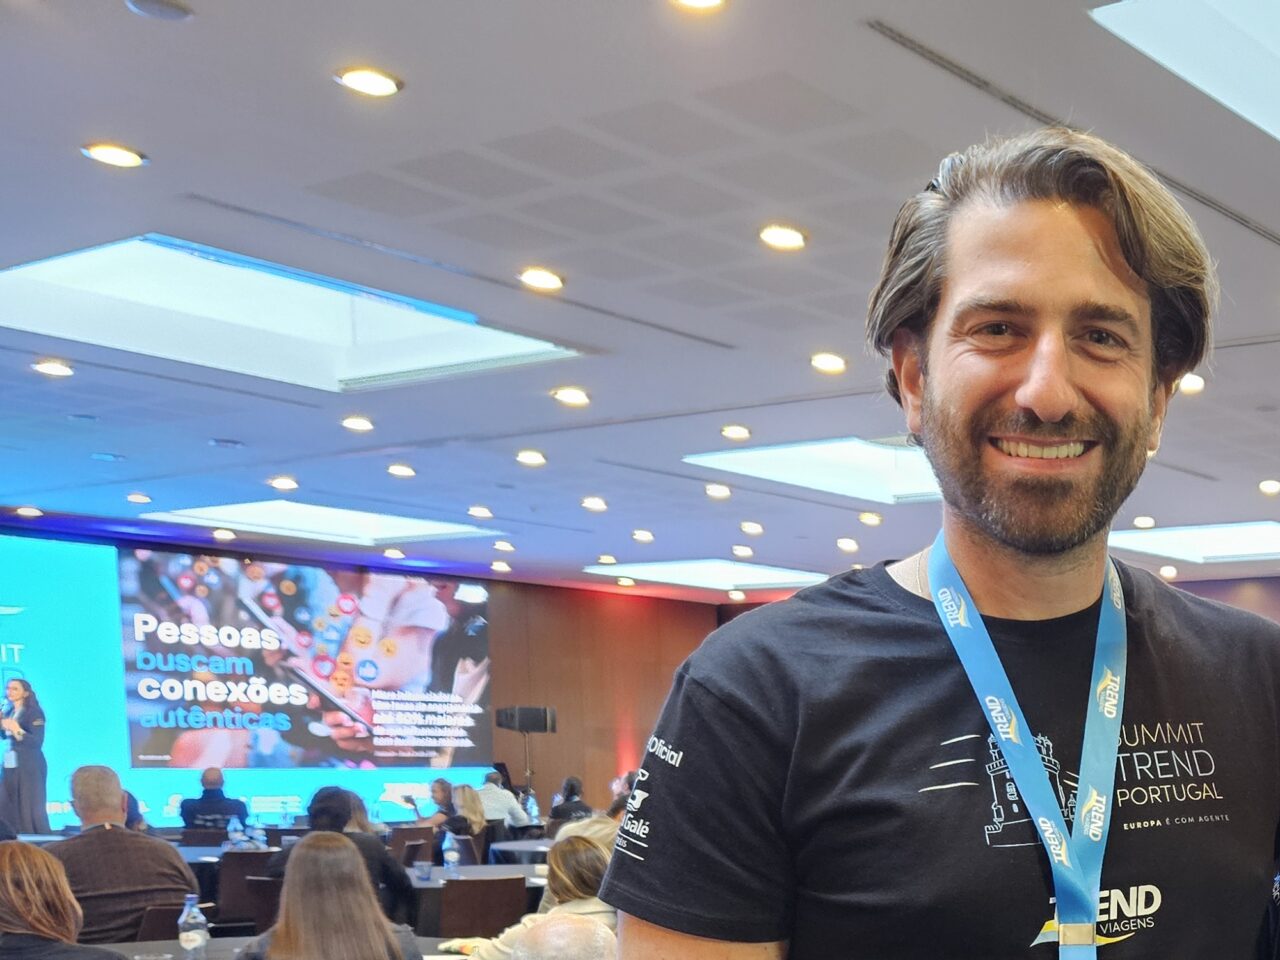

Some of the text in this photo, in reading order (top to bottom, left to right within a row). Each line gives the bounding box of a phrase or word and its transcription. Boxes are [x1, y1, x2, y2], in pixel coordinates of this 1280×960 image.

[938, 588, 960, 628] TREND
[133, 613, 281, 650] Pessoas
[136, 651, 254, 675] buscam
[137, 677, 308, 705] conexões
[1104, 675, 1121, 718] TREND
[140, 705, 292, 731] autênticas
[985, 696, 1011, 742] TREND
[648, 736, 683, 767] Oficial
[1117, 750, 1216, 781] TREND
[1116, 782, 1224, 807] PORTUGAL
[623, 814, 650, 838] Galé
[1089, 795, 1107, 841] TREND
[1123, 814, 1230, 830] EUROPA É COM AGENTE
[1038, 817, 1064, 864] TREND
[1100, 917, 1155, 934] VIAGENS
